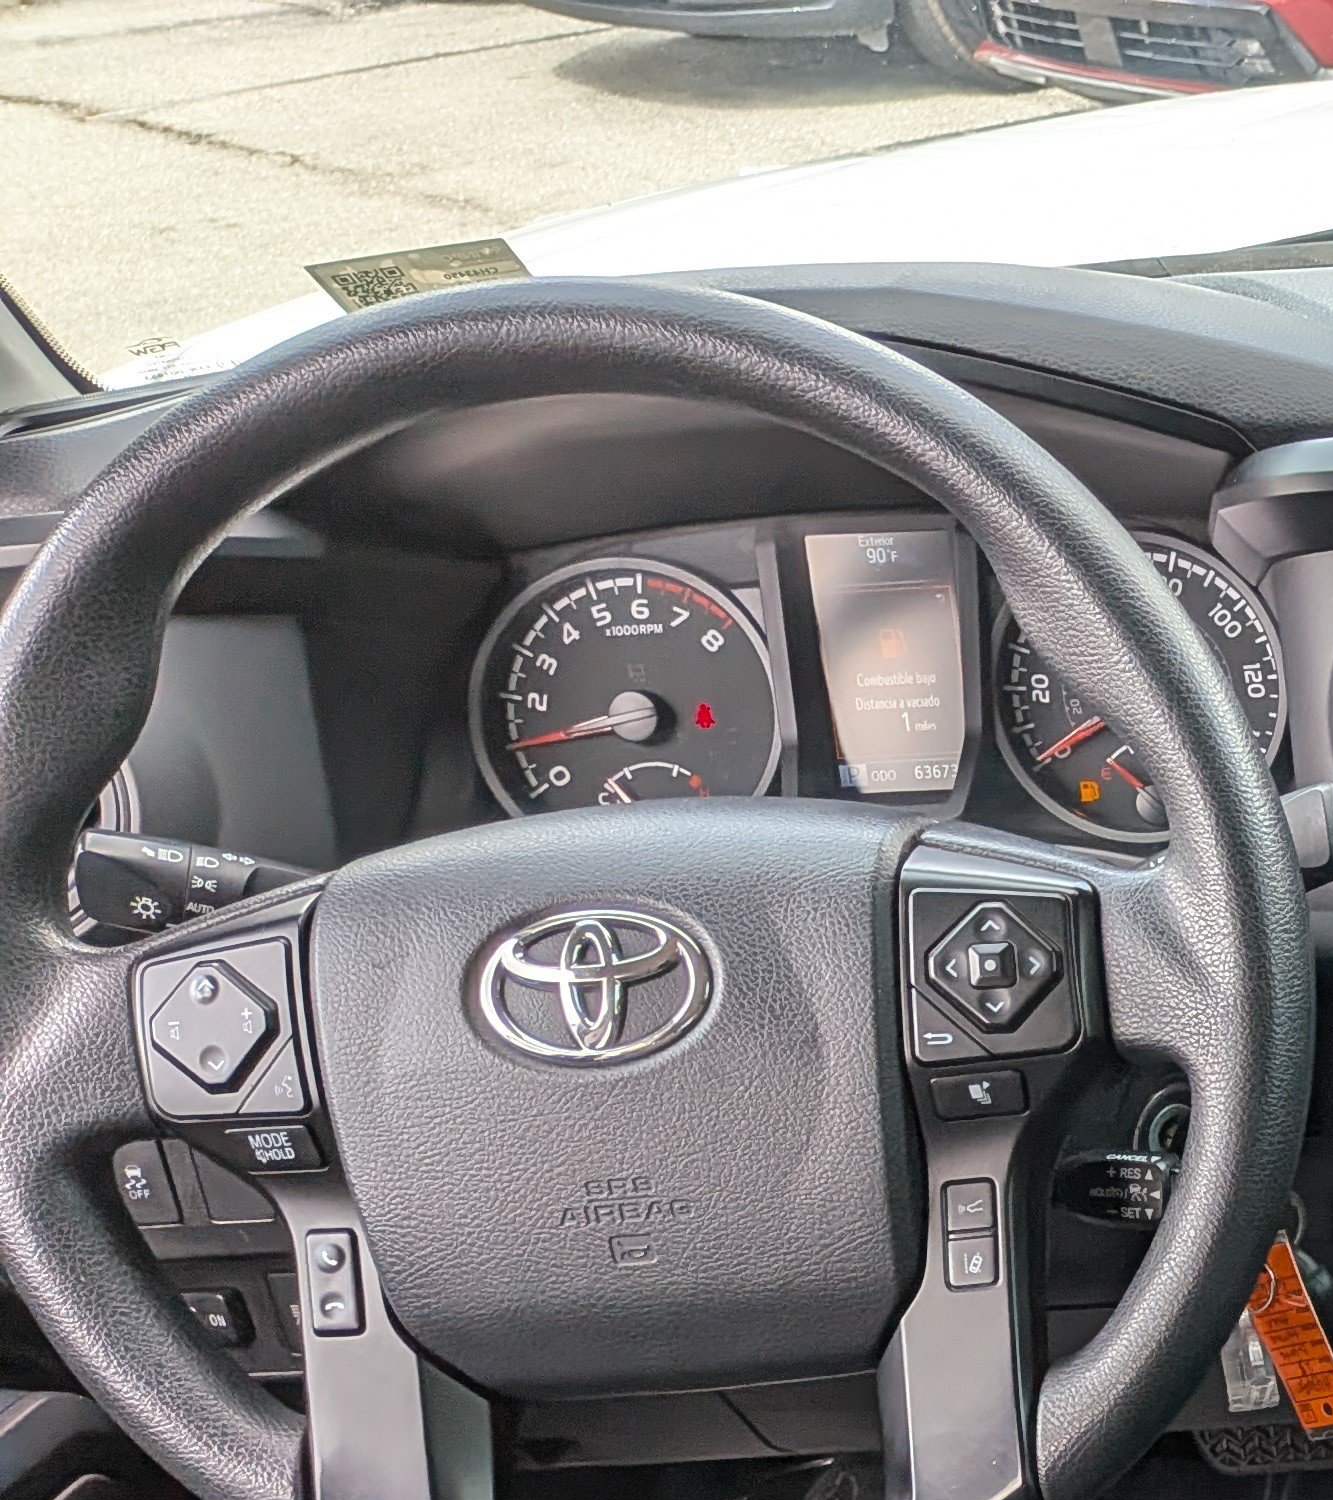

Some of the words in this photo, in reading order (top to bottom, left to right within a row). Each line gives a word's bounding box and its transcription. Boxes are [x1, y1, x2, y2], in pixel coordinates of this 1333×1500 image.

[590, 602, 612, 627] 5
[630, 598, 650, 620] 6
[669, 605, 690, 628] 7
[1207, 602, 1242, 638] 100
[562, 621, 580, 645] 4
[701, 628, 725, 652] 8
[535, 653, 558, 676] 3
[856, 672, 914, 687] Combustible
[915, 672, 936, 686] bajo
[1030, 673, 1050, 704] 20
[1242, 662, 1266, 698] 120
[526, 692, 548, 712] 2
[855, 696, 897, 711] Distancia
[901, 711, 911, 732] 1
[549, 765, 571, 786] 0
[871, 769, 897, 781] ODO
[185, 901, 215, 915] AUTO
[247, 1131, 292, 1149] MODE
[265, 1147, 296, 1161] HOLD
[1120, 1167, 1142, 1180] RES
[128, 1189, 150, 1200] OFF
[558, 1199, 697, 1227] AIRBAG
[1120, 1206, 1141, 1219] SET
[208, 1313, 227, 1327] ON
